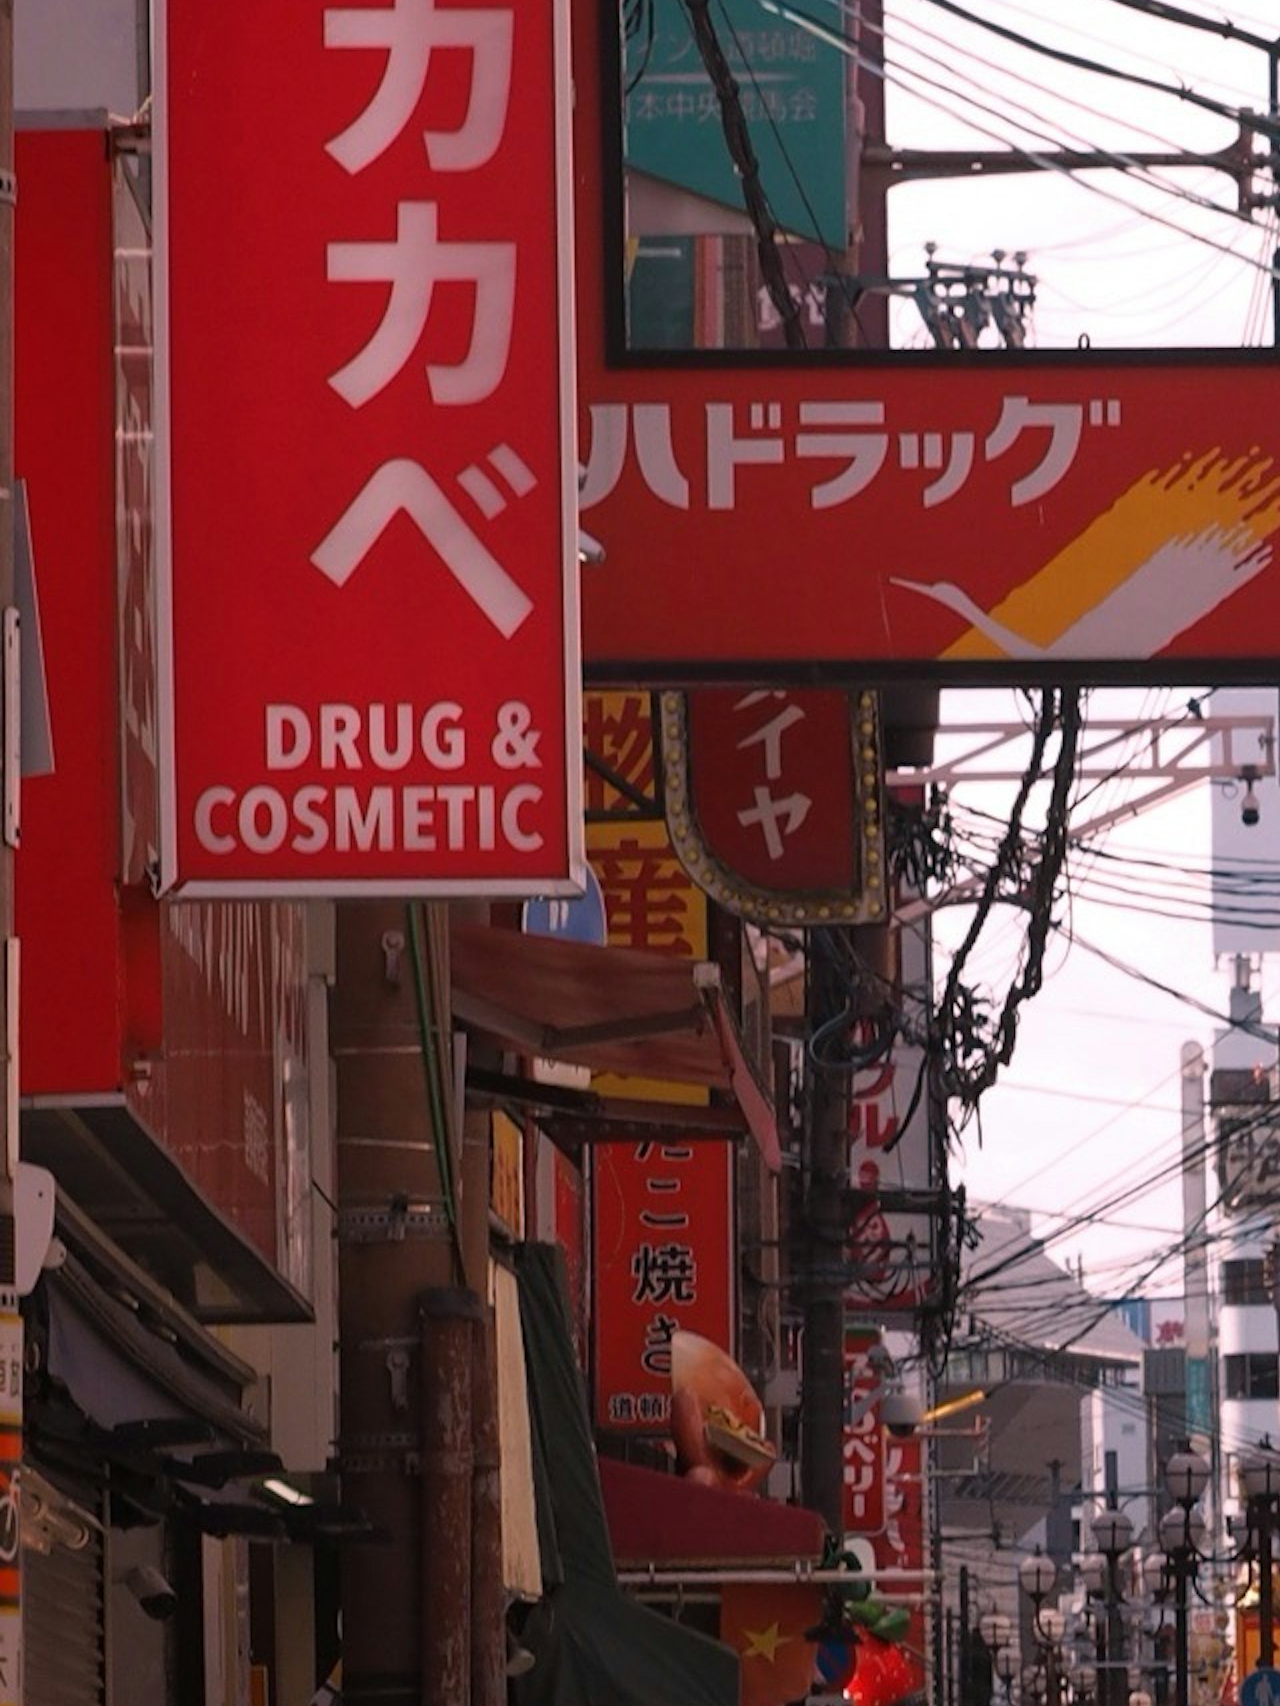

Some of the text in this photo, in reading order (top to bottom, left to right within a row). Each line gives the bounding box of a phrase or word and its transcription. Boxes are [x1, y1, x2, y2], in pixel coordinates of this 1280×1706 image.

[579, 396, 1122, 512] ハドラッグ
[265, 700, 544, 773] DRUG &
[733, 691, 813, 861] イヤ
[193, 783, 546, 856] COSMETIC
[609, 1397, 673, 1424] 道頓
